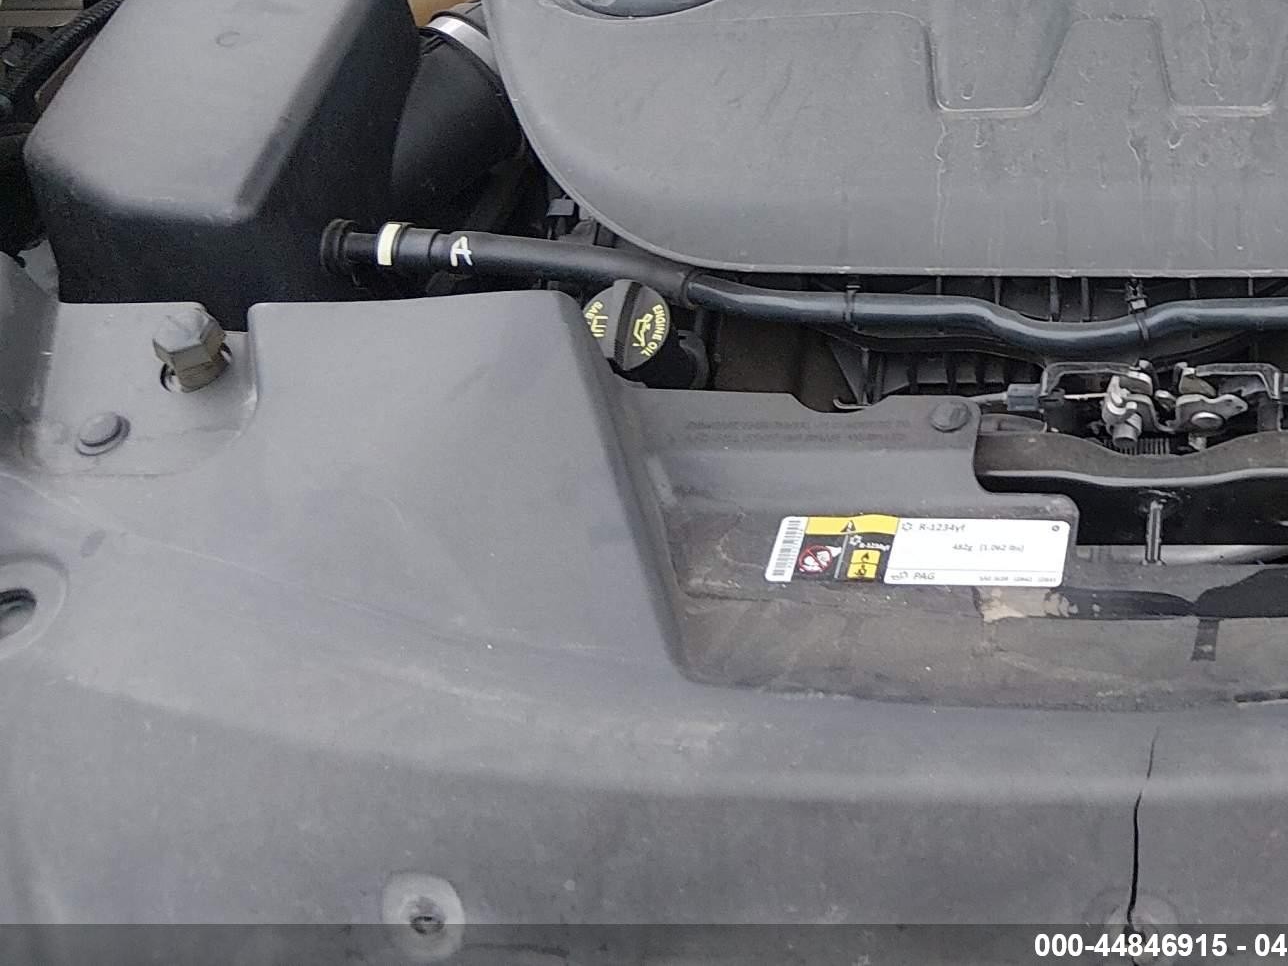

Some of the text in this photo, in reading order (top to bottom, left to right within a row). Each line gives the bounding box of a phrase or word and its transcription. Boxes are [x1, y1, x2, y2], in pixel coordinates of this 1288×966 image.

[640, 304, 667, 357] ENGINE OIL
[918, 521, 966, 532] R-1234yf
[913, 572, 936, 581] PAG
